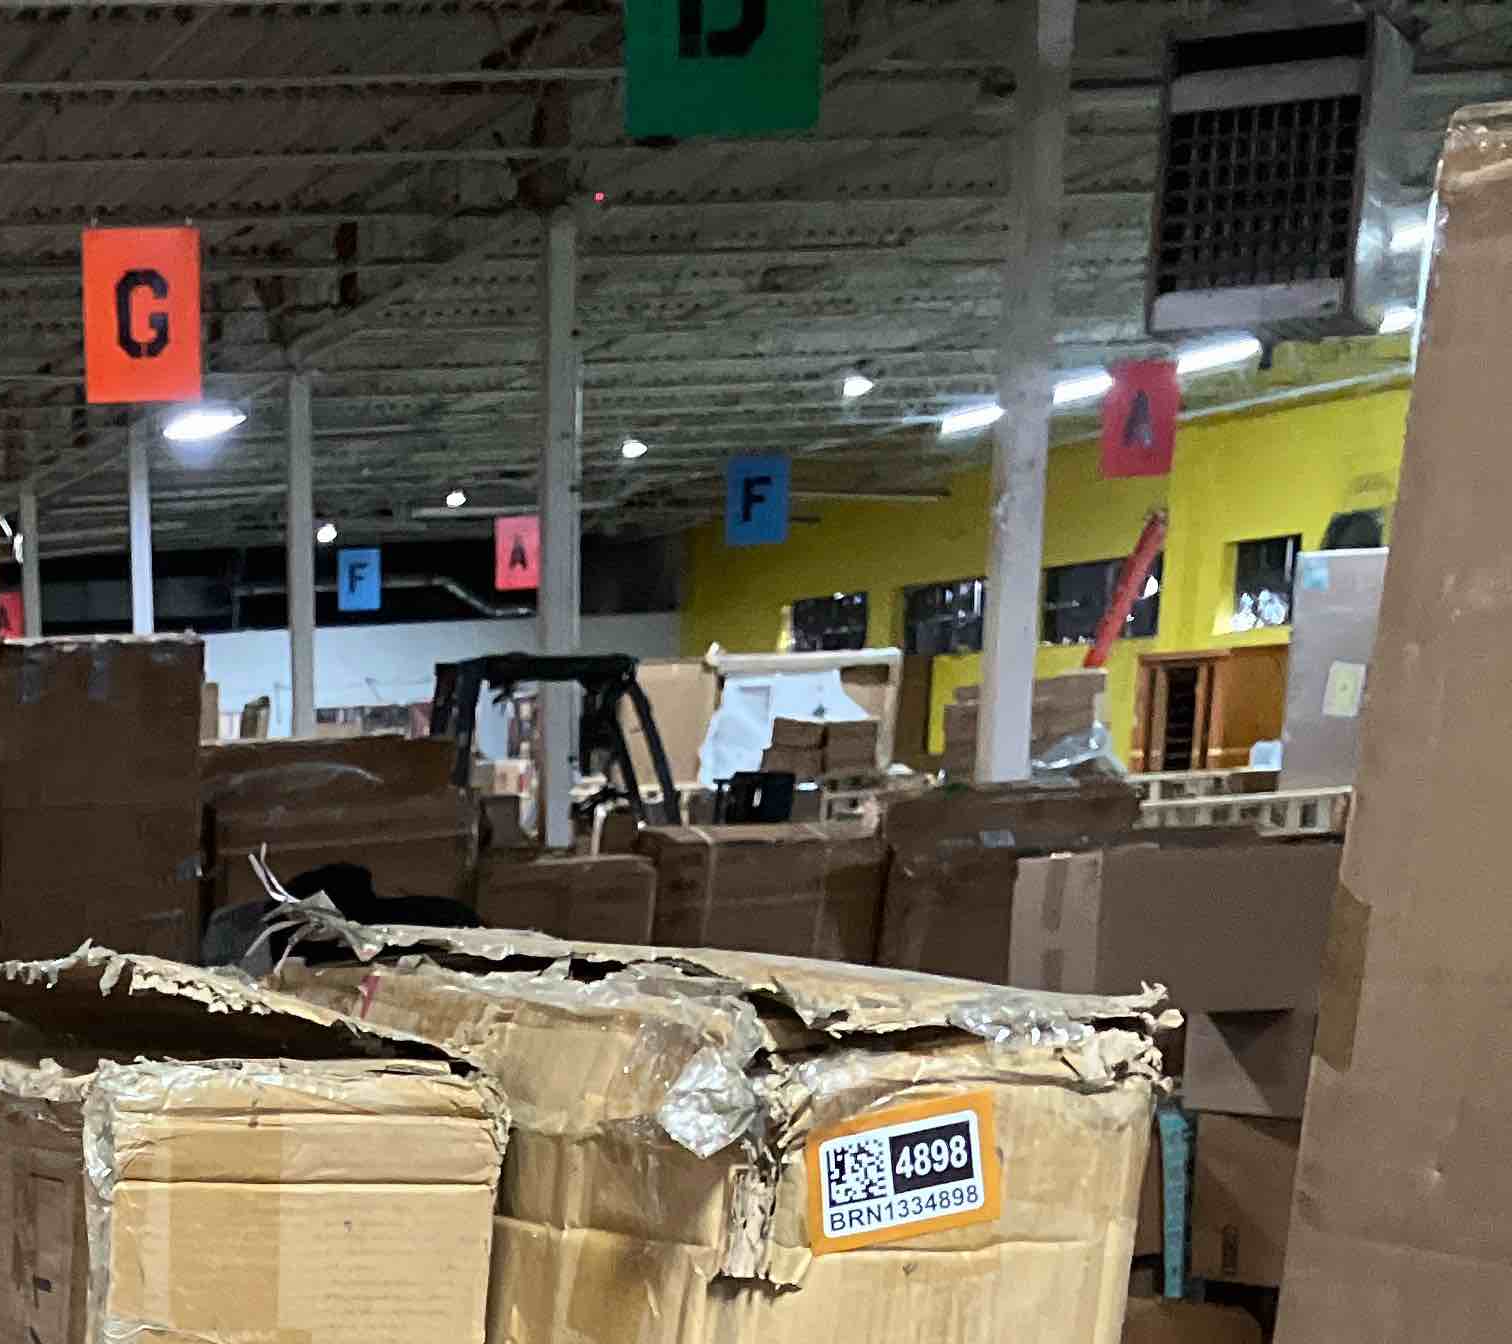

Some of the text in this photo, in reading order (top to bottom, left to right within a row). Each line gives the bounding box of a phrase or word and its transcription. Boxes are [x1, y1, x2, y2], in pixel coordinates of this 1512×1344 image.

[114, 270, 168, 359] G
[1123, 391, 1154, 451] A
[740, 476, 774, 523] F
[348, 561, 369, 594] F
[508, 538, 528, 573] A
[895, 1134, 970, 1179] 4898
[830, 1185, 979, 1233] BRN1334898
